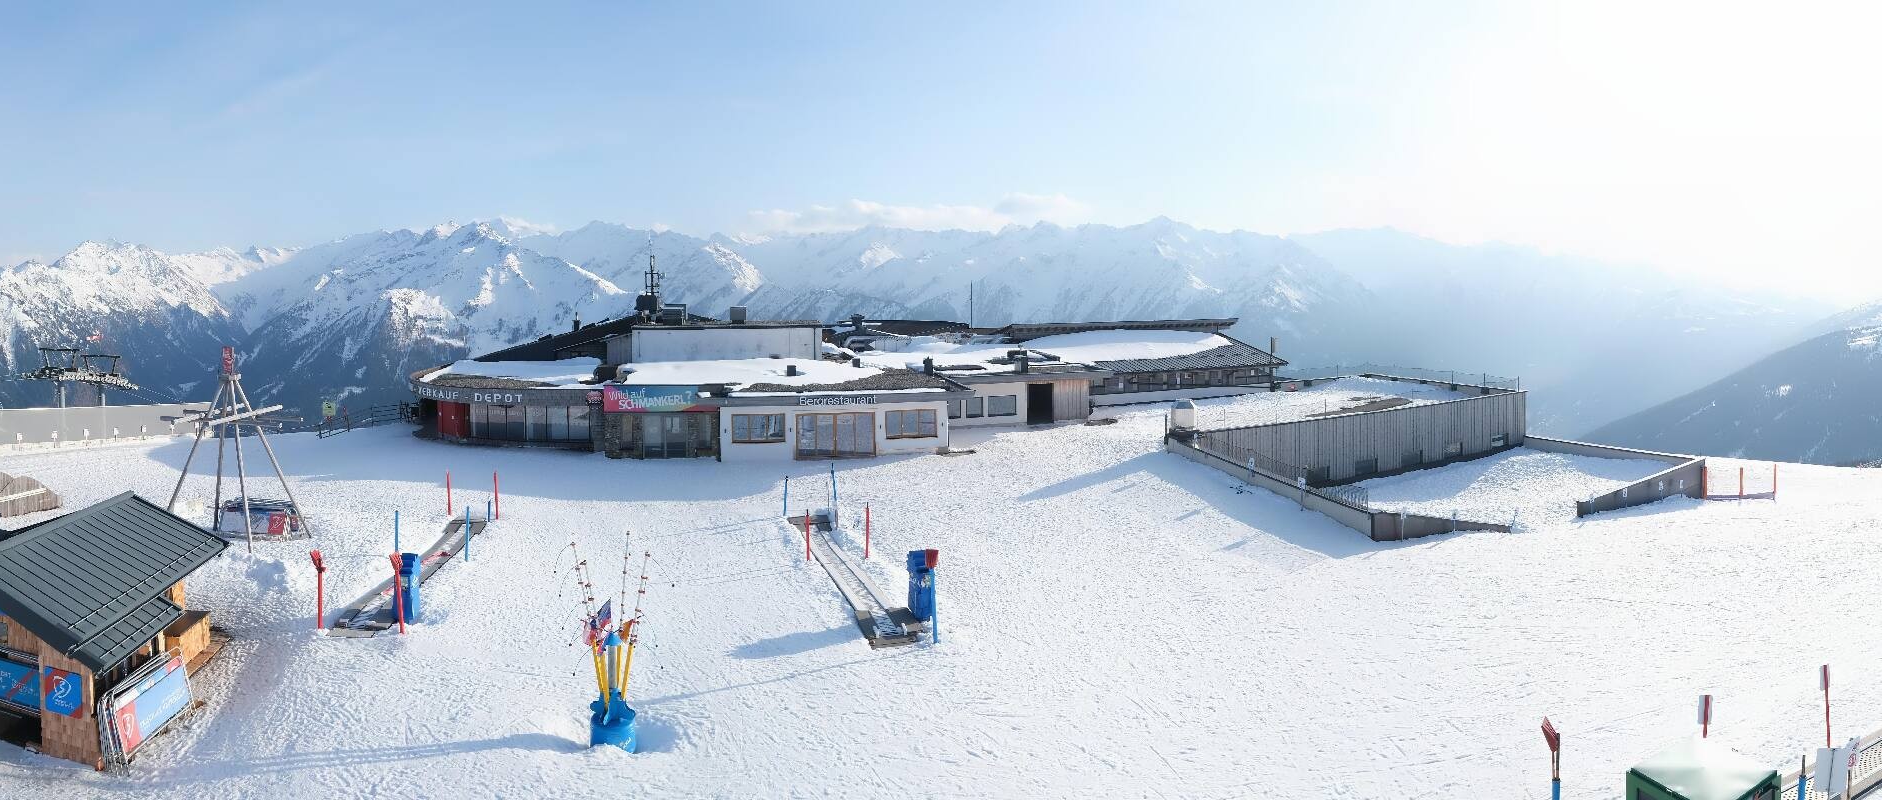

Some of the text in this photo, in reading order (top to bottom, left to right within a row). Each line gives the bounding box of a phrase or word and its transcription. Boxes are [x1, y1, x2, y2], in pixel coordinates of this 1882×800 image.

[417, 385, 459, 400] VERKAUF
[474, 392, 523, 403] DEPOT
[608, 387, 646, 401] Wild auf
